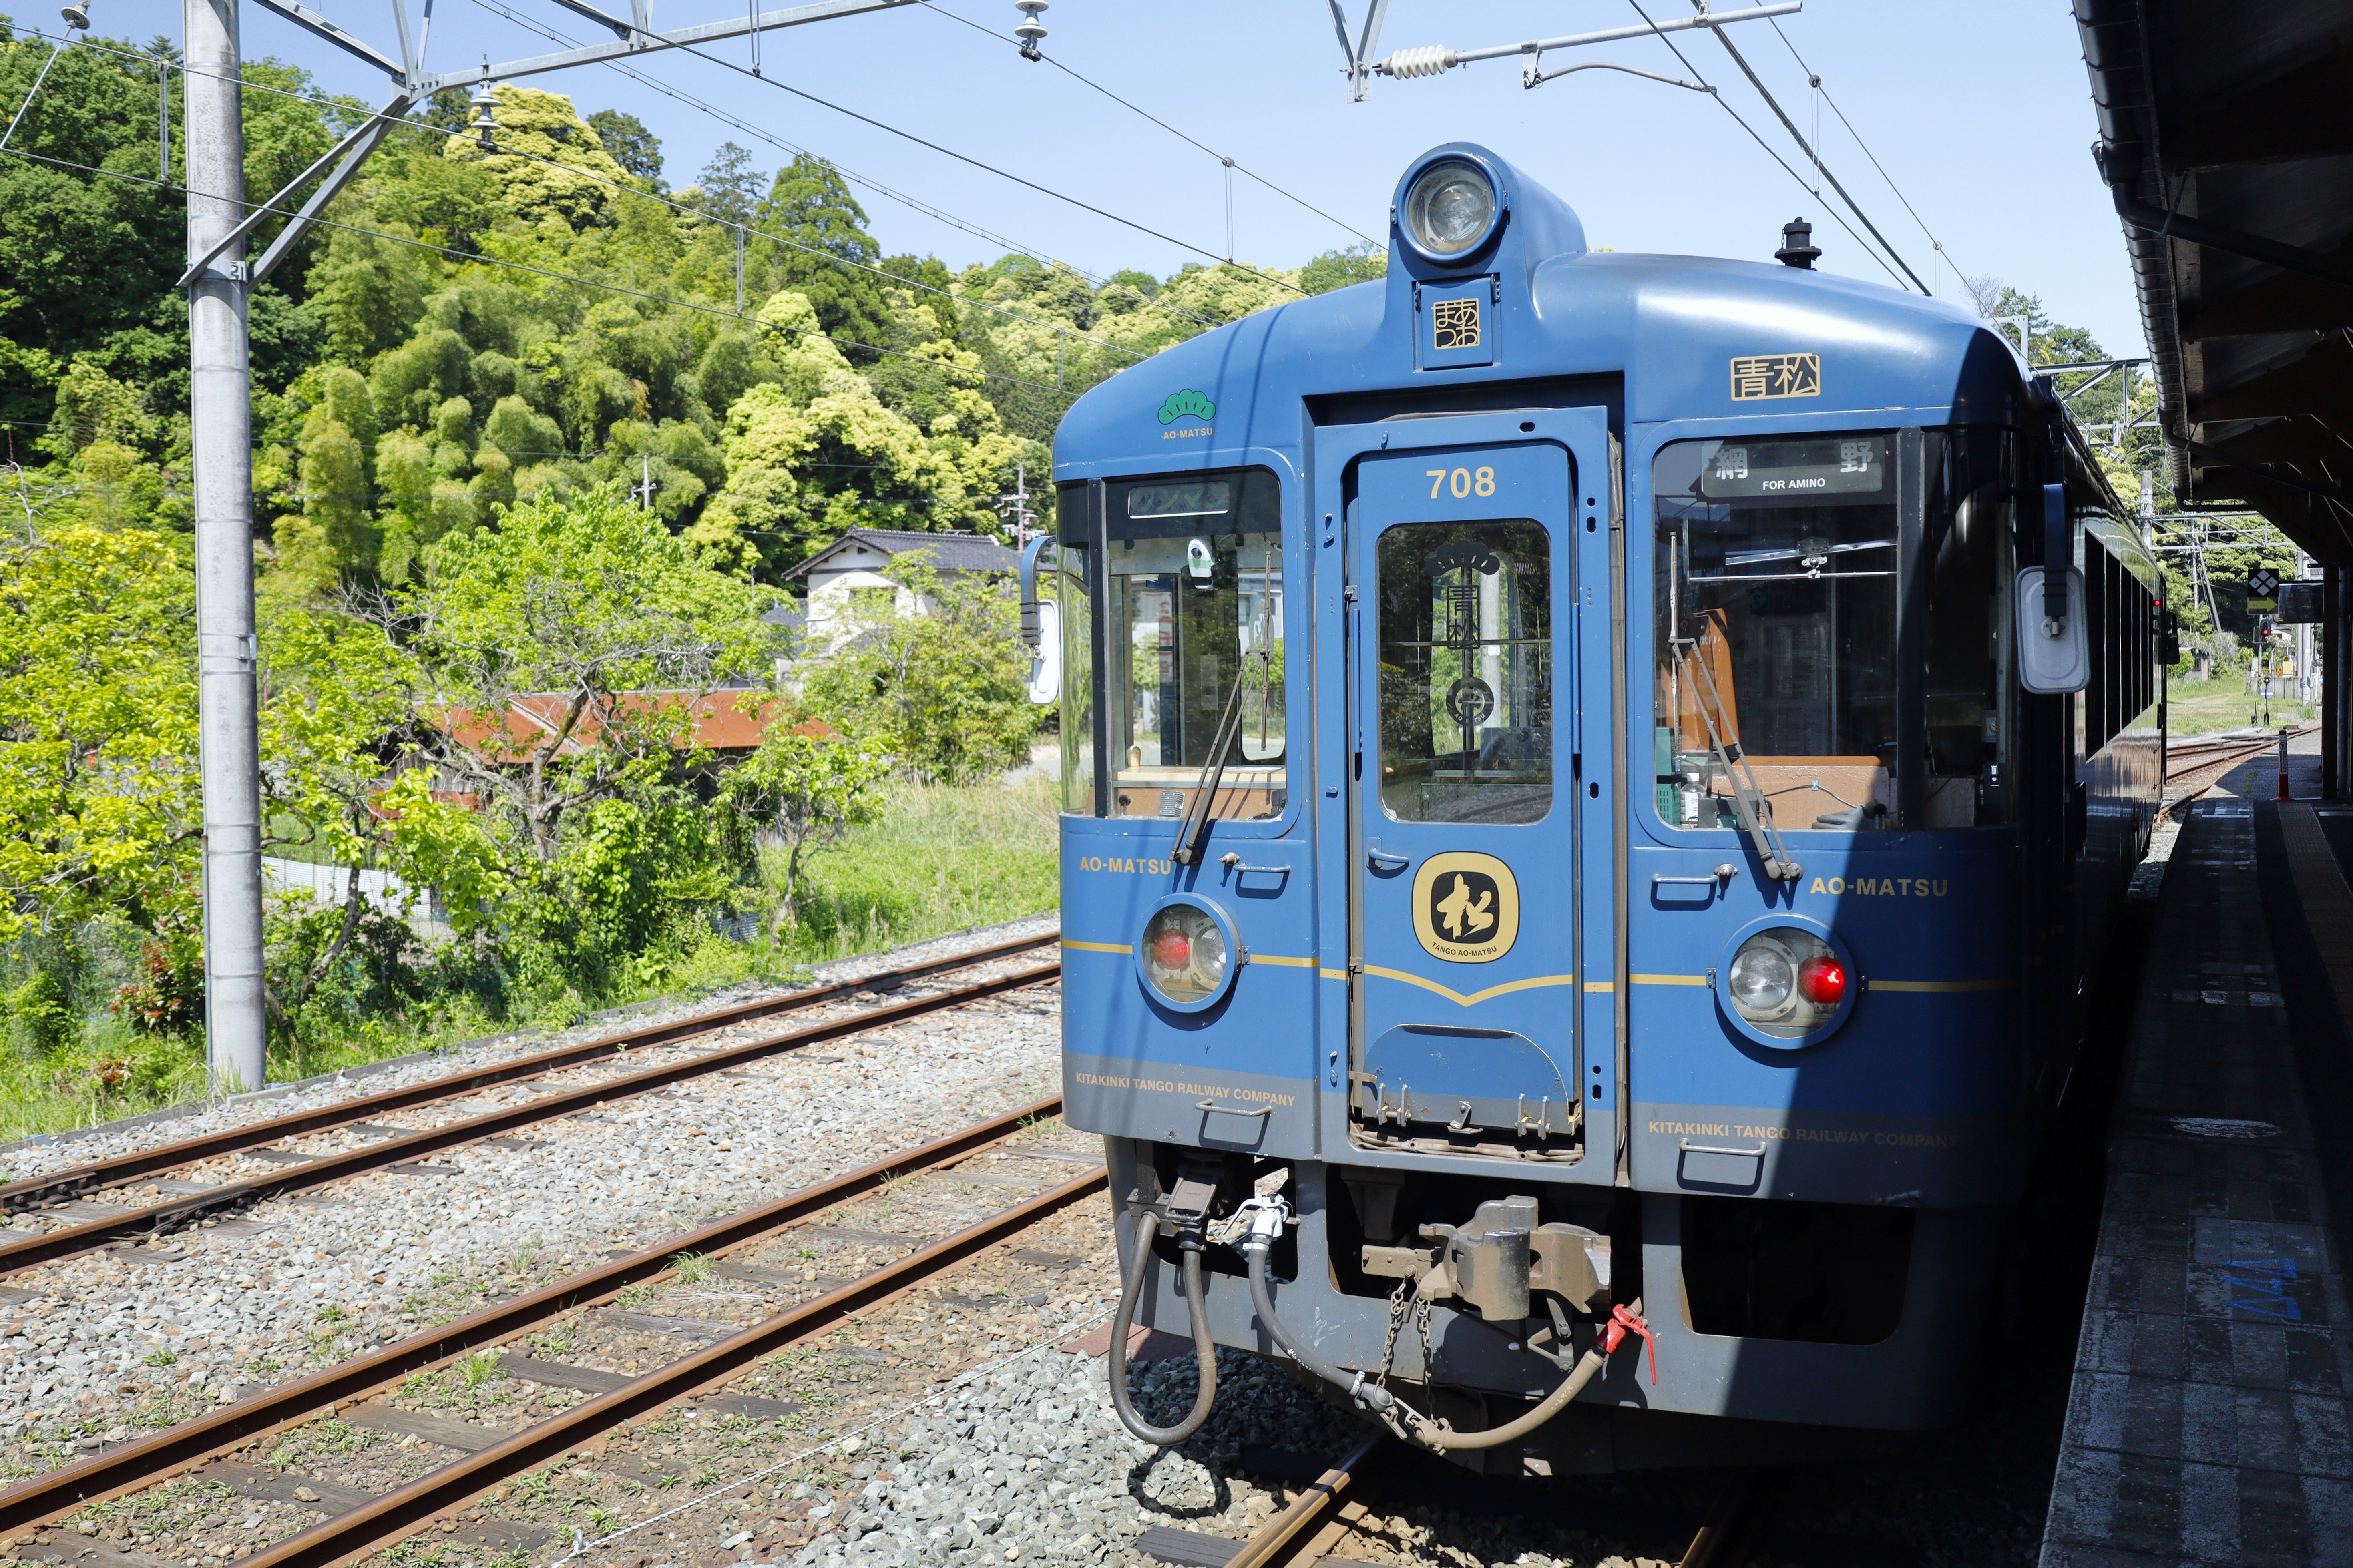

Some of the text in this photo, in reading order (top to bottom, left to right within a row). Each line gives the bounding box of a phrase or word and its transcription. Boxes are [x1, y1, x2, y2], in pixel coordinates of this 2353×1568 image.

[1731, 353, 1821, 401] 青松
[1163, 427, 1213, 440] AO-MATSU
[1426, 466, 1496, 499] 708
[1763, 478, 1825, 490] FOR AMINO
[1454, 713, 1485, 724] AOTSU
[1079, 857, 1171, 875] AO-MATSU
[1810, 877, 1947, 897] AO-MATSU
[1432, 942, 1497, 956] TANGO AO-MATSU
[1076, 1072, 1296, 1106] KITAKINKI TANGO RAILWAY COMPANY
[1649, 1121, 1957, 1148] KITAKINKI TANGO RAILWAY COMPANY
